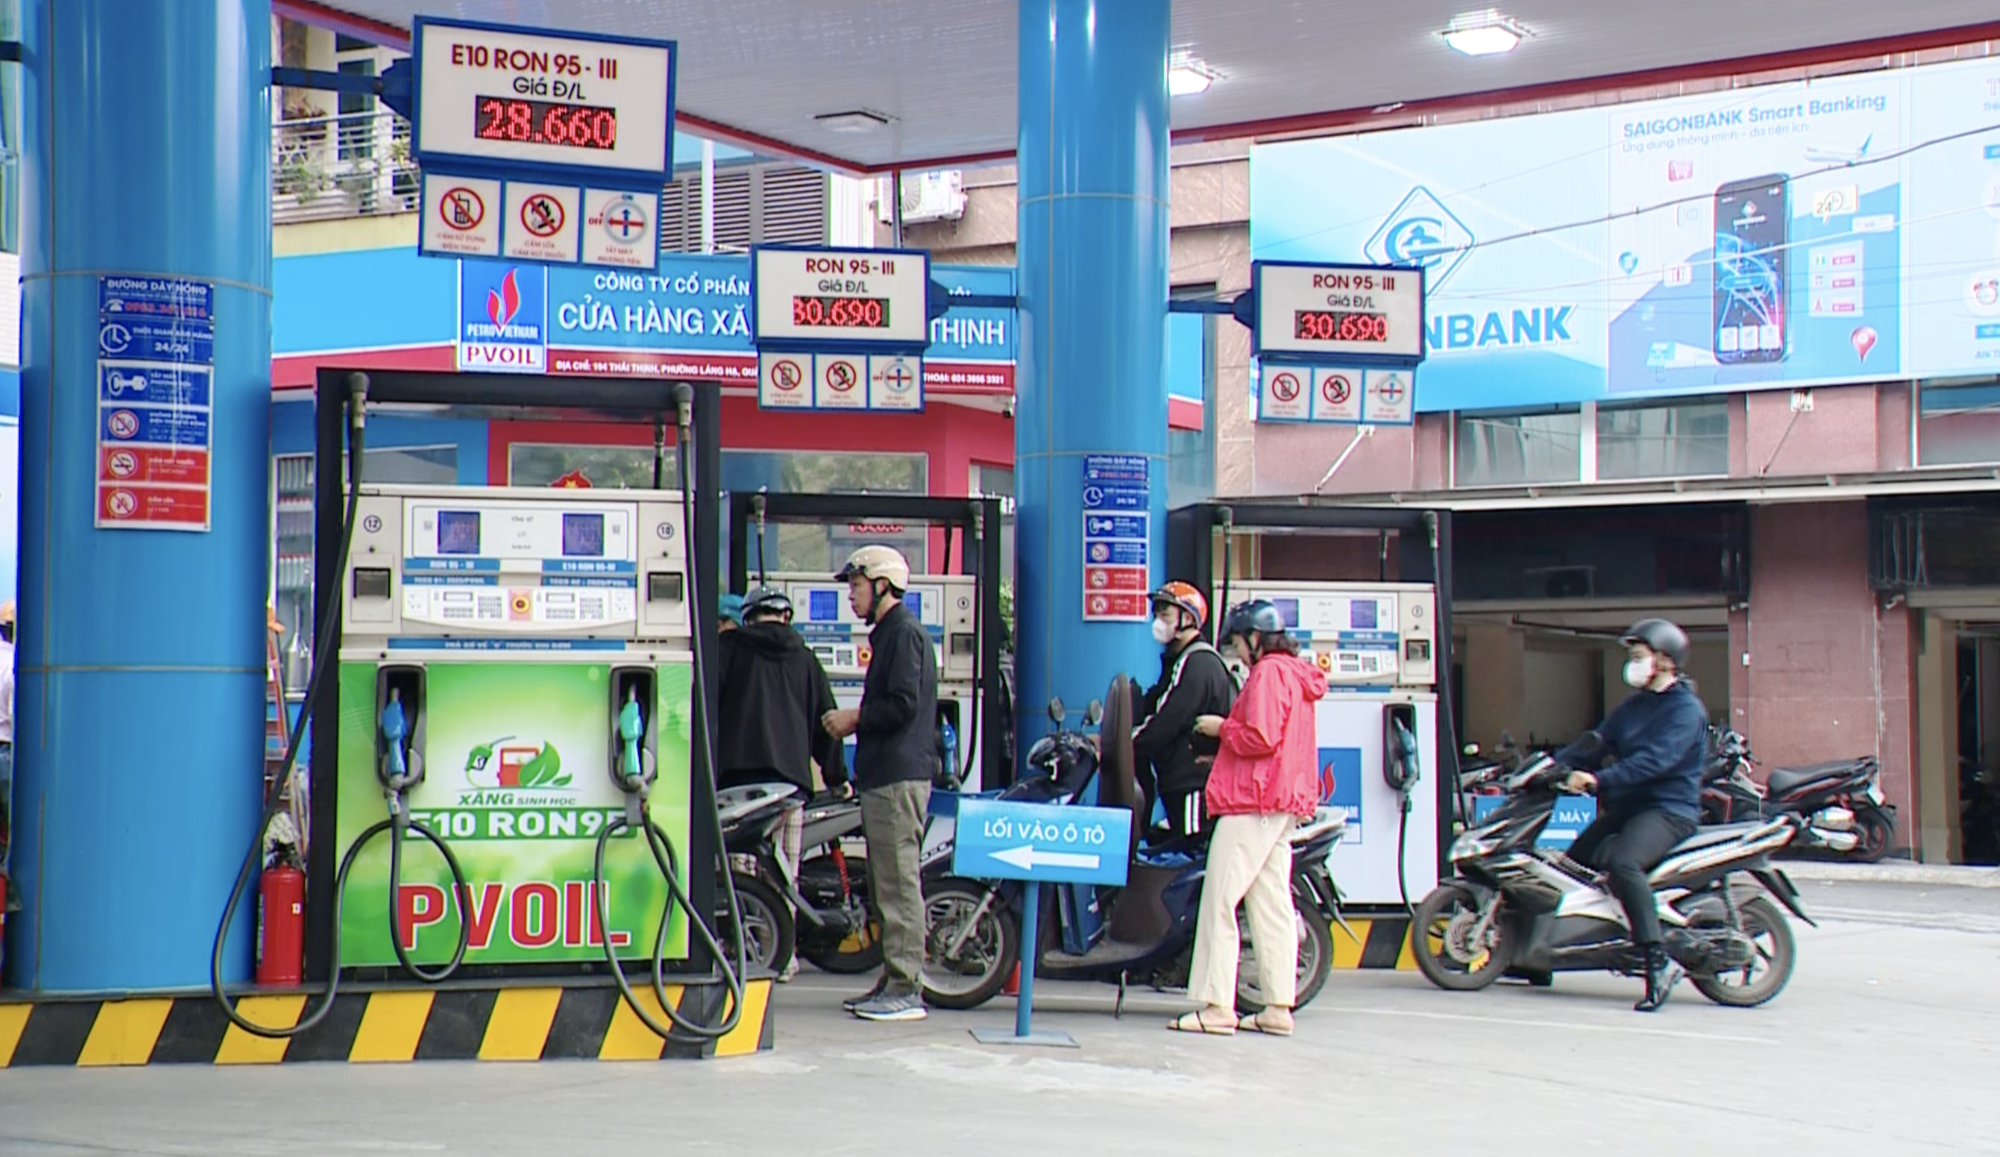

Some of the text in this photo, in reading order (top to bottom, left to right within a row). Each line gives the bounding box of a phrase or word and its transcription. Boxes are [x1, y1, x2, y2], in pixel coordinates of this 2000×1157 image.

[451, 44, 488, 67] E10
[494, 48, 548, 73] RON
[554, 54, 581, 76] 95
[599, 58, 617, 79] III
[513, 77, 586, 100] Giá Đ/L
[481, 101, 615, 149] 28.660
[1623, 93, 1887, 138] SAIGONBANK Smart Banking
[1711, 130, 1738, 142] minh
[588, 217, 603, 226] OFF
[806, 258, 844, 274] RON
[849, 259, 870, 274] 95
[882, 260, 895, 275] III
[594, 271, 644, 292] CÔNG
[648, 276, 671, 293] TY
[675, 271, 699, 294] CỔ
[818, 279, 869, 294] Giá Đ/L
[1313, 274, 1349, 289] RON
[1353, 276, 1373, 290] 95
[1383, 277, 1395, 291] III
[1327, 294, 1376, 308] Giá Đ/L
[467, 323, 539, 339] PETROVIETNAM
[558, 294, 1005, 349] CỬA HÀNG XĂ THỊNH
[1300, 312, 1388, 341] 30.690
[1425, 306, 1572, 349] NBANK
[467, 346, 536, 365] PVOIL
[458, 792, 577, 807] XĂNG SINH HỌC
[1559, 808, 1591, 823] MÁY
[984, 815, 1105, 844] LỐI VÀO Ô TÔ
[397, 881, 631, 950] PVOIL
